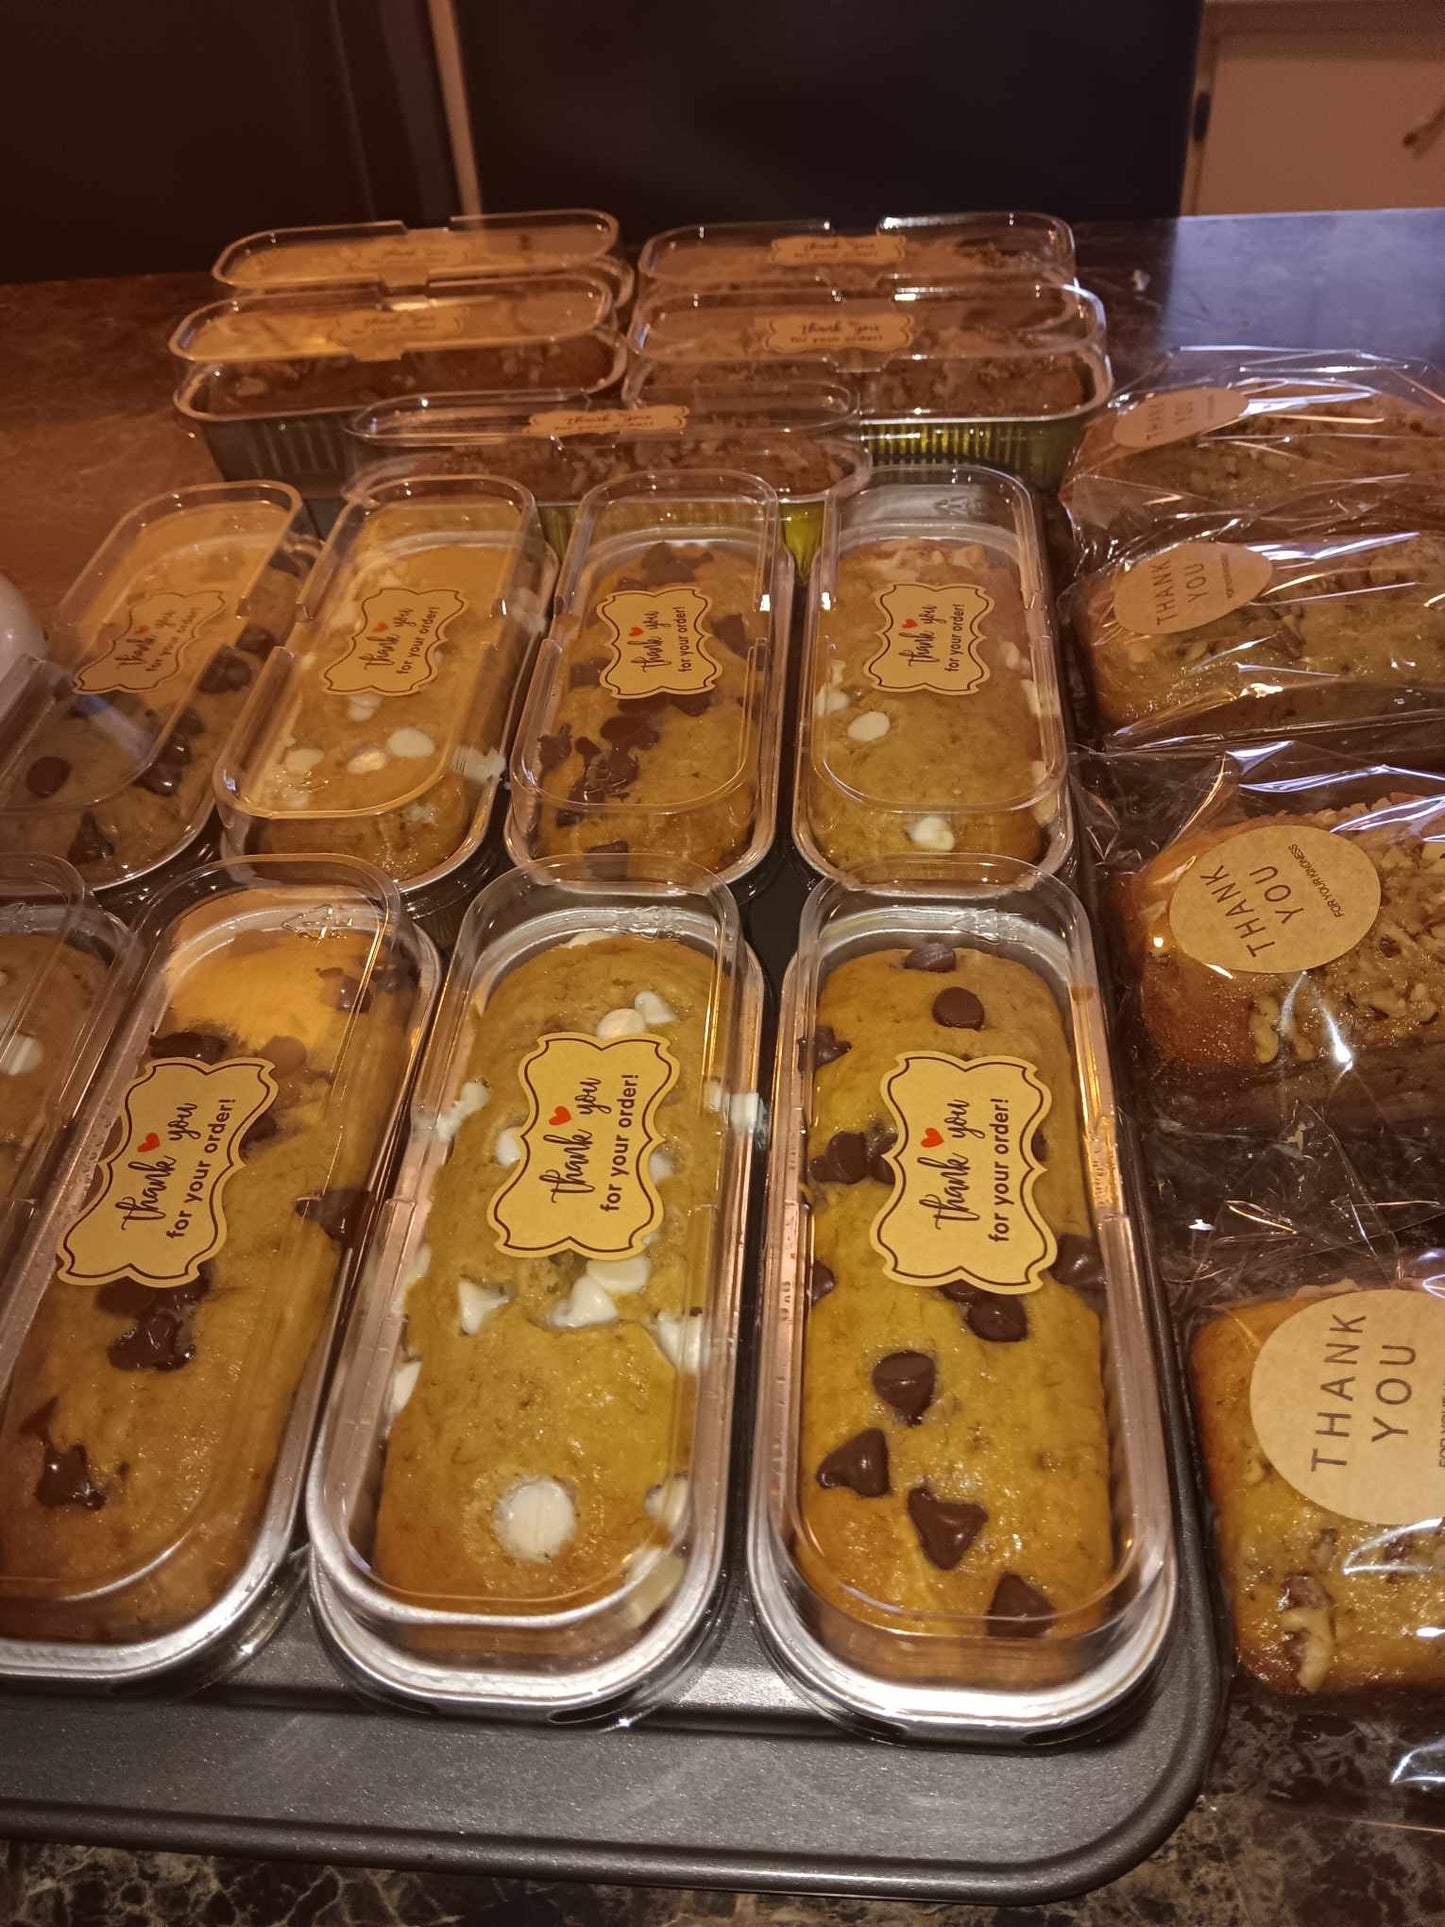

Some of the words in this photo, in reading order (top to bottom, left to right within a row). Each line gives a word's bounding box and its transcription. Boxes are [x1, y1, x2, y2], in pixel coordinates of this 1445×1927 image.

[1151, 560, 1177, 626] THANK
[1183, 563, 1208, 603] YOU
[642, 610, 671, 630] you
[672, 606, 688, 633] order!
[918, 604, 947, 625] you
[949, 604, 965, 632] order!
[358, 634, 400, 670] thank
[396, 661, 413, 675] for
[408, 637, 424, 658] your
[419, 606, 441, 635] order!
[627, 636, 672, 673] thank
[679, 636, 695, 657] your
[898, 630, 940, 667] thank
[949, 634, 964, 656] your
[677, 659, 692, 672] for
[944, 658, 960, 672] for
[1288, 844, 1319, 879] KINDNESS
[1249, 865, 1305, 924] YOU
[1312, 877, 1331, 901] YOUR
[1200, 865, 1275, 958] THANK
[1327, 899, 1344, 918] FOR
[616, 1074, 639, 1129] order!
[943, 1099, 986, 1139] you
[539, 1128, 596, 1204] thank
[574, 1077, 612, 1115] you
[989, 1098, 1010, 1155] order!
[115, 1155, 178, 1231] thank
[167, 1103, 201, 1141] you
[166, 1210, 193, 1239] for
[184, 1160, 211, 1202] your
[204, 1099, 236, 1154] order!
[610, 1134, 630, 1178] your
[599, 1183, 622, 1212] for
[916, 1152, 981, 1230] thank
[993, 1161, 1015, 1206] your
[988, 1214, 1010, 1242] for
[1310, 1313, 1367, 1473] THANK
[1370, 1344, 1417, 1443] YOU
